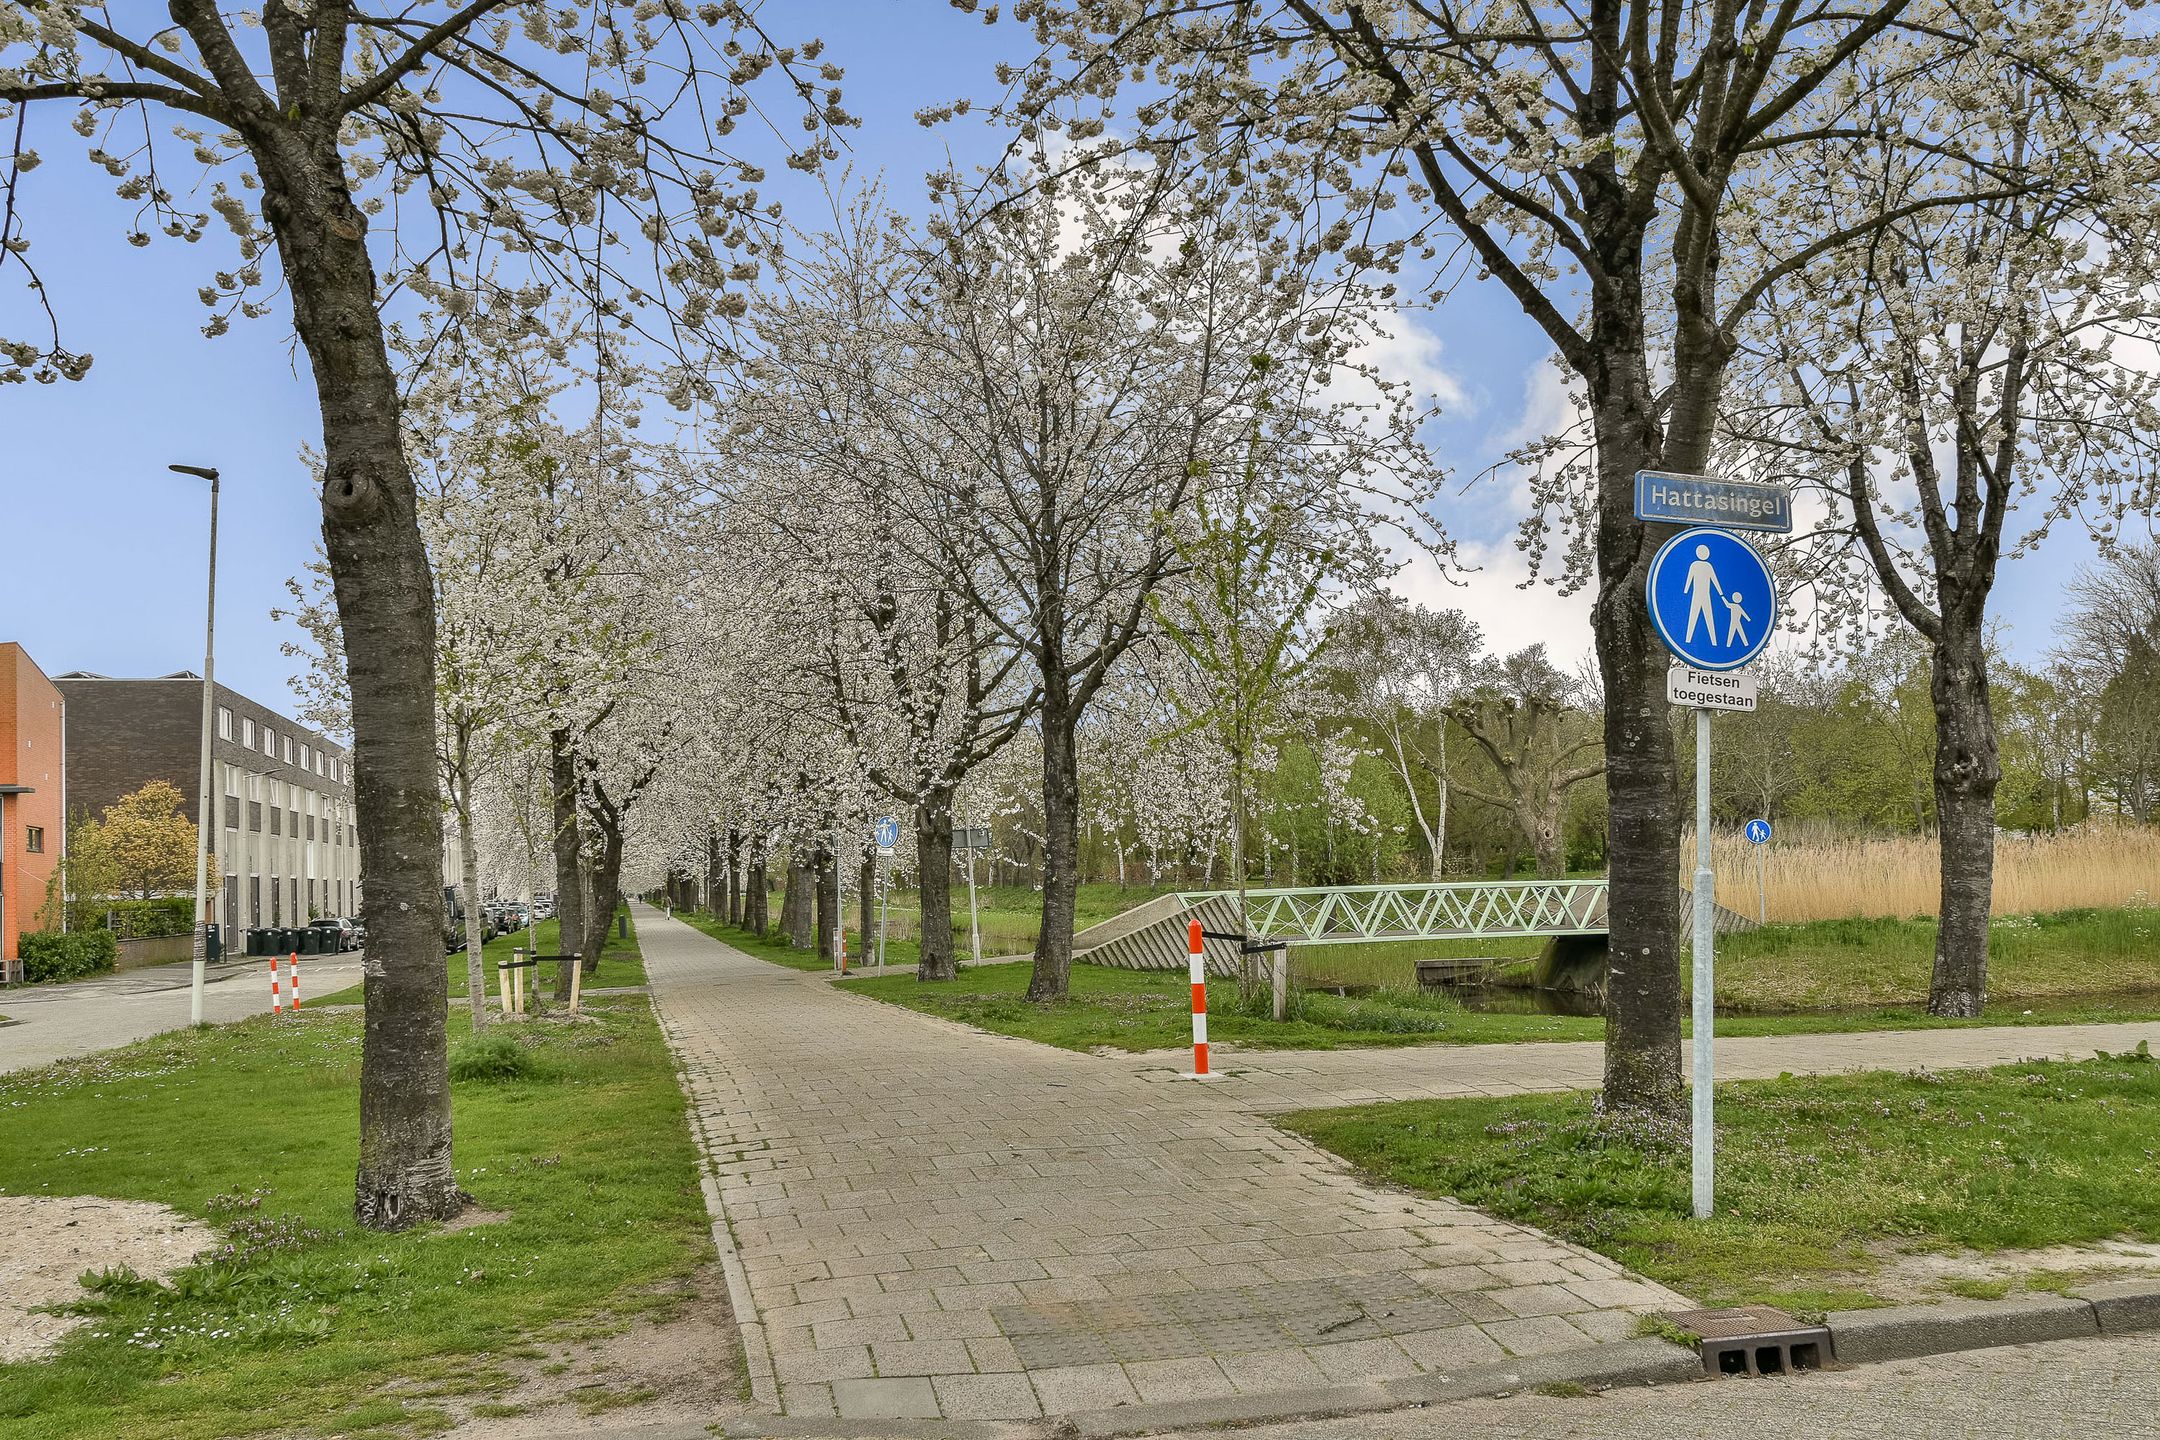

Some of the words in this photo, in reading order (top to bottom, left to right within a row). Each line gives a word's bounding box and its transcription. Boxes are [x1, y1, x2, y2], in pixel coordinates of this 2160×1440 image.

[1651, 484, 1780, 517] Hattasingel
[1688, 671, 1740, 688] Fietsen
[1673, 687, 1753, 707] toegestaan
